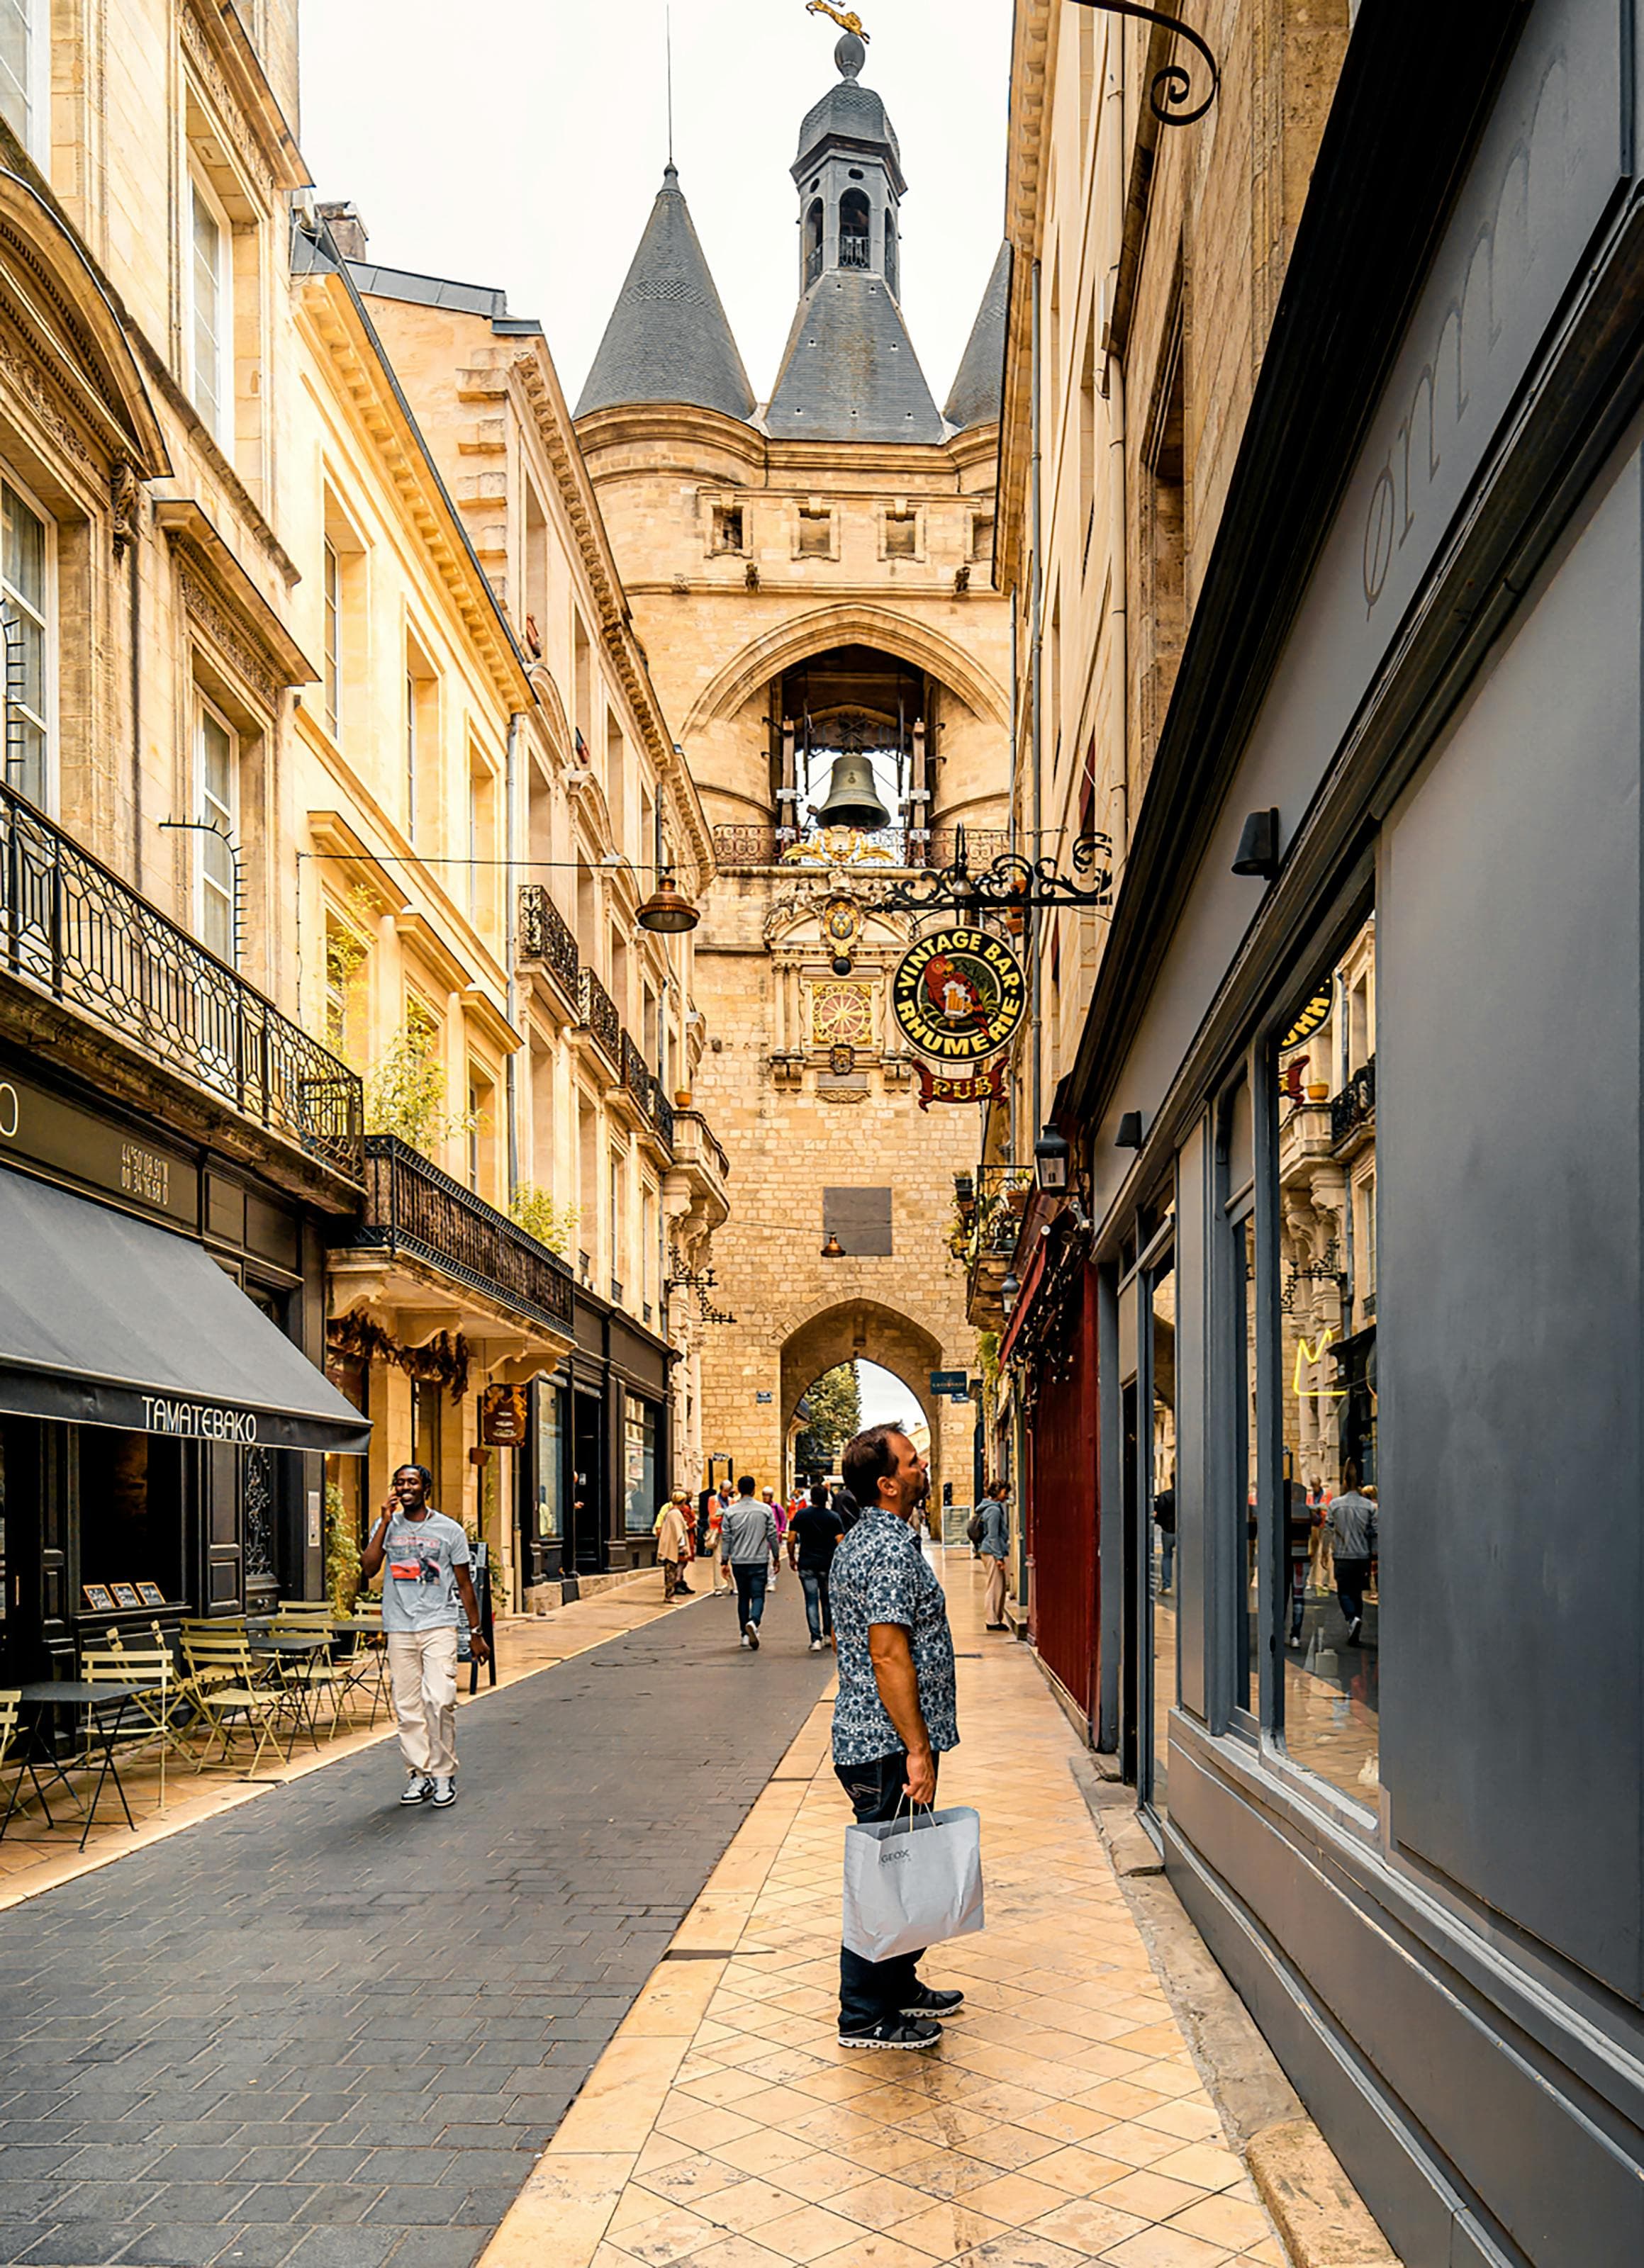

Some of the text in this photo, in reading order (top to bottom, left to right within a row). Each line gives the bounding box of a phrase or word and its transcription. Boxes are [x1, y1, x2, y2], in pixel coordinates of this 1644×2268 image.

[898, 931, 1020, 989] VINTAGE BAR
[897, 997, 1021, 1055] RHUMERIE
[932, 1076, 992, 1099] PUB
[142, 1396, 257, 1442] TAMATEBAKO
[880, 1849, 910, 1863] GEOX
